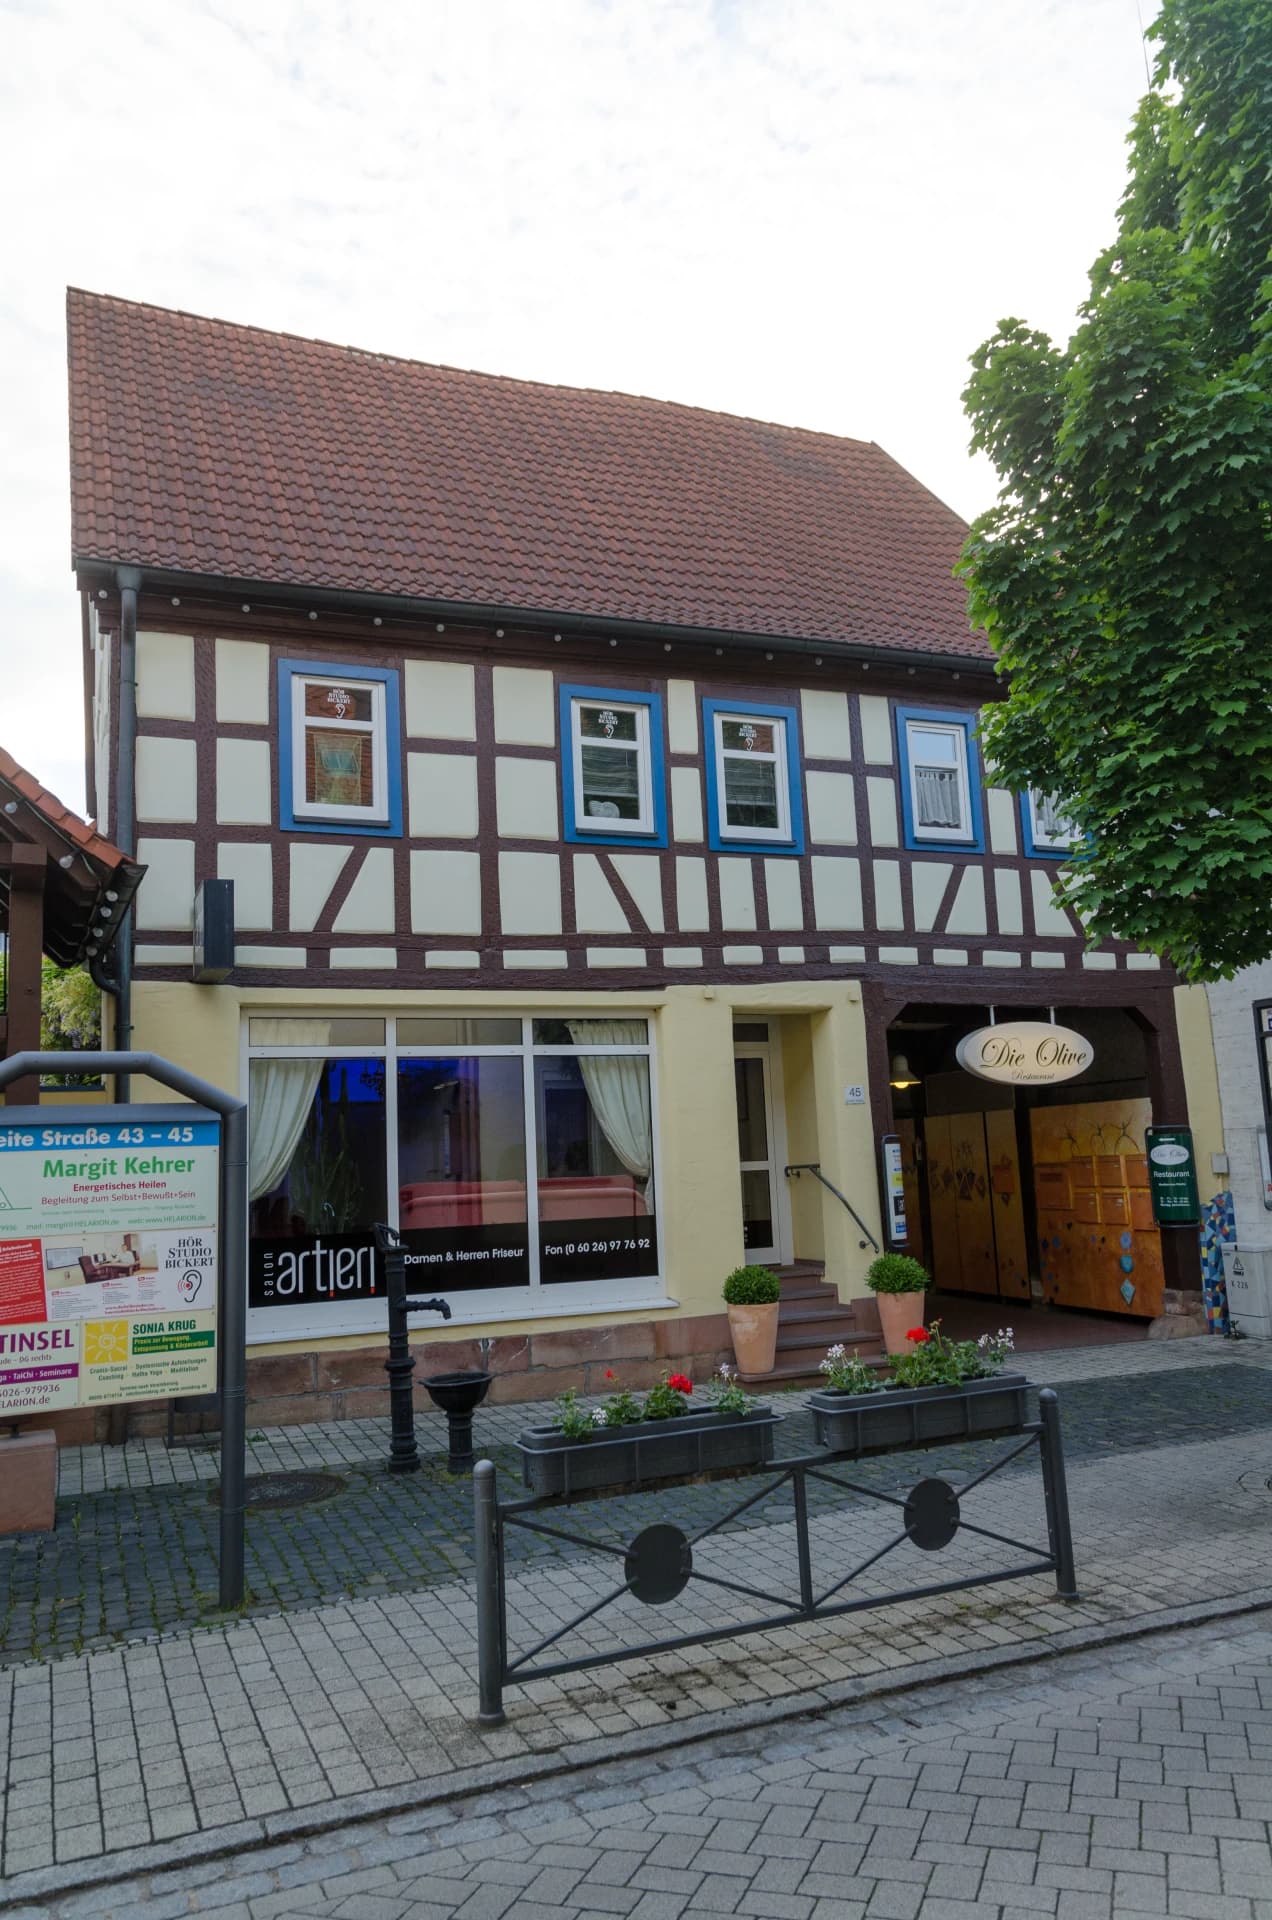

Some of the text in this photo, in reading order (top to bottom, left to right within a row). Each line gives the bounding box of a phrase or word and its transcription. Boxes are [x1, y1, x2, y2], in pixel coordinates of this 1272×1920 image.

[980, 1037, 1087, 1068] Die Olive
[849, 1087, 861, 1097] 45
[41, 1128, 111, 1146] Straße
[117, 1127, 144, 1144] 43
[167, 1126, 194, 1143] 45
[43, 1156, 195, 1180] Margit Kehrer
[73, 1180, 167, 1192] Energetisches Heilen
[41, 1195, 89, 1206] Begleitung
[178, 1236, 203, 1248] HÖR
[545, 1238, 650, 1256] Fon (0 60 26) 97 76 92
[168, 1247, 212, 1258] STUDIO
[404, 1247, 524, 1265] Damen & Herren Friseur
[165, 1257, 214, 1269] BICKERT
[264, 1252, 274, 1296] salon
[133, 1319, 197, 1335] SONIA KRUG
[13, 1371, 34, 1380] TaiChi
[40, 1368, 72, 1377] Seminare
